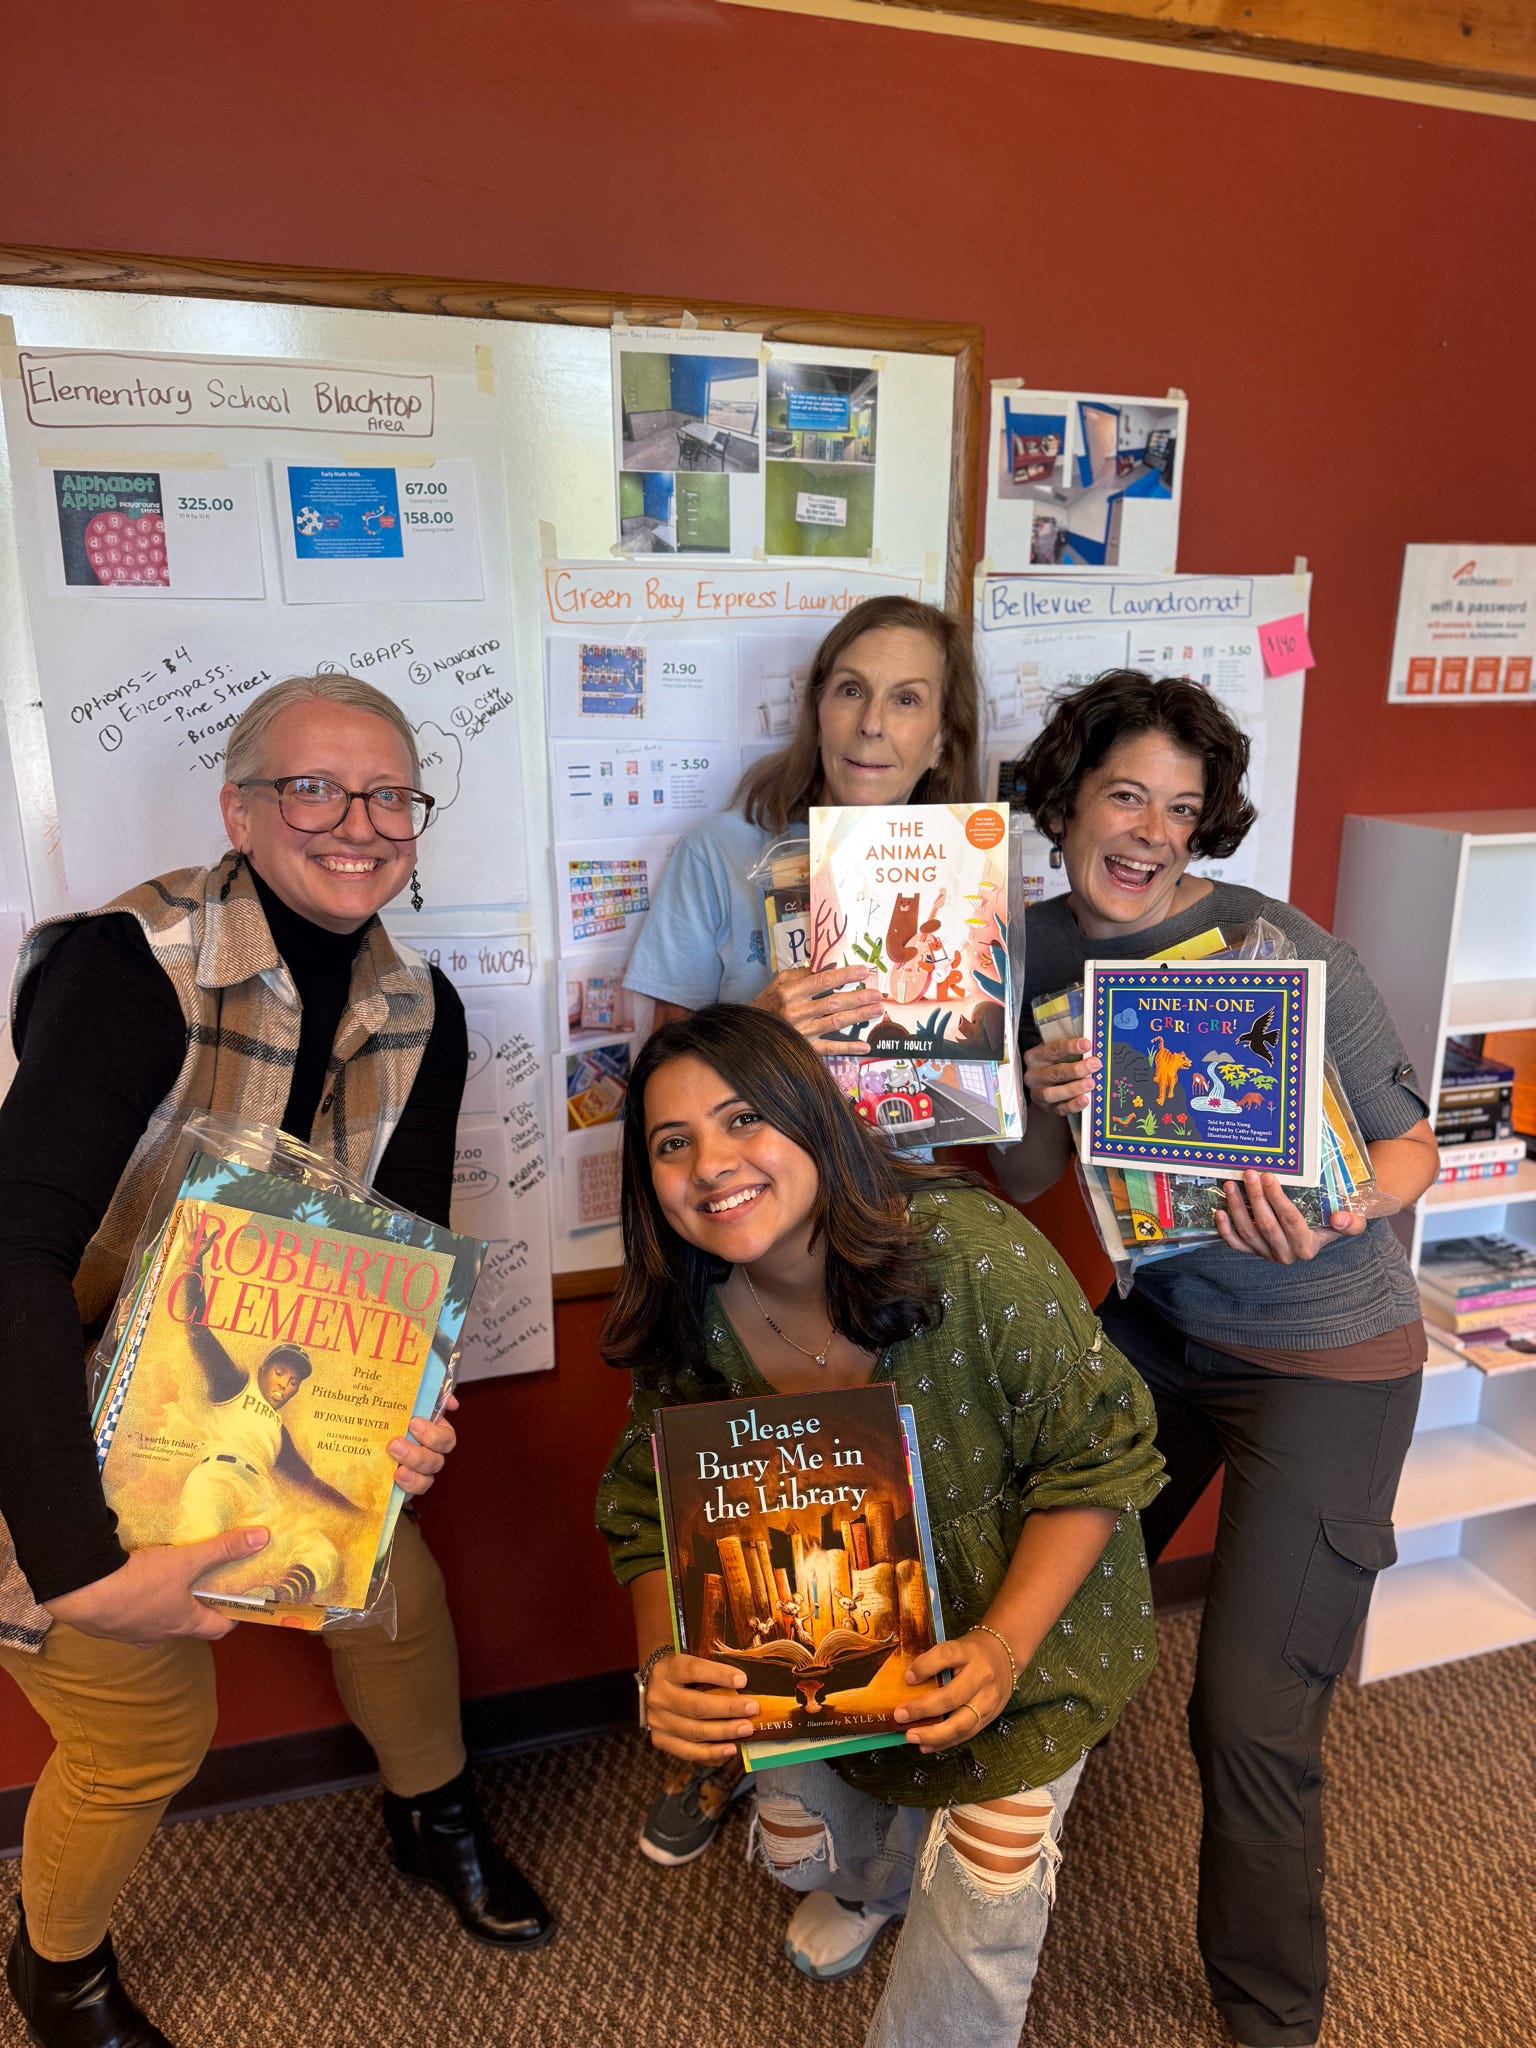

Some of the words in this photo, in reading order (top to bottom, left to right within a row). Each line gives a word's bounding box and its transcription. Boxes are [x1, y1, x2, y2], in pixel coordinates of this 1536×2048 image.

[28, 367, 192, 414] Elementary
[207, 379, 290, 414] School
[314, 382, 422, 419] Blacktop
[368, 417, 405, 432] Area
[61, 475, 155, 493] Alphabet
[405, 482, 448, 495] 67.00
[61, 492, 118, 511] Apple
[178, 497, 234, 511] 325.00
[403, 512, 454, 524] 158.00
[554, 573, 631, 612] Green
[645, 577, 685, 619] Bay
[697, 581, 777, 615] Express
[992, 585, 1093, 620] Bellevue
[1109, 585, 1245, 616] Laundromat
[349, 638, 414, 668] GBAPS
[433, 639, 501, 672] Navarino
[455, 664, 496, 685] Park
[662, 662, 697, 675] 21.90
[71, 676, 141, 724] Options
[175, 700, 213, 722] Pine
[213, 668, 272, 704] Street
[681, 759, 709, 770] 3.50
[886, 821, 923, 837] THE
[865, 843, 947, 860] ANIMAL
[875, 865, 937, 883] SONG
[447, 949, 468, 971] to
[477, 947, 525, 974] YWCA
[1138, 998, 1255, 1013] NINE-IN-ONE
[1150, 1016, 1191, 1034] GRR!
[1197, 1018, 1237, 1034] GRR!
[876, 1039, 900, 1050] JONTY
[904, 1041, 933, 1051] HOWLEY
[455, 1148, 482, 1160] 7.00
[183, 1212, 440, 1312] ROBERTO
[167, 1271, 426, 1366] CLEMENTE
[353, 1367, 382, 1382] Pride
[353, 1382, 361, 1390] of
[361, 1384, 373, 1392] the
[311, 1385, 369, 1407] Pittsburgh
[371, 1396, 409, 1412] Pirates
[313, 1410, 325, 1420] BY
[325, 1412, 355, 1425] JONAH
[356, 1417, 390, 1430] WINTER
[727, 1408, 821, 1448] Please
[144, 1436, 169, 1446] worthy
[316, 1438, 343, 1452] RAÚL
[342, 1443, 373, 1456] COLÓN
[695, 1451, 770, 1482] Bury
[776, 1443, 824, 1475] Me
[832, 1438, 865, 1468] in
[703, 1485, 750, 1523] the
[755, 1476, 868, 1514] Library
[760, 1721, 794, 1731] LEWIS
[807, 1719, 834, 1728] Illustrated
[834, 1719, 842, 1727] by
[844, 1714, 874, 1725] KYLE
[876, 1714, 890, 1723] M.
